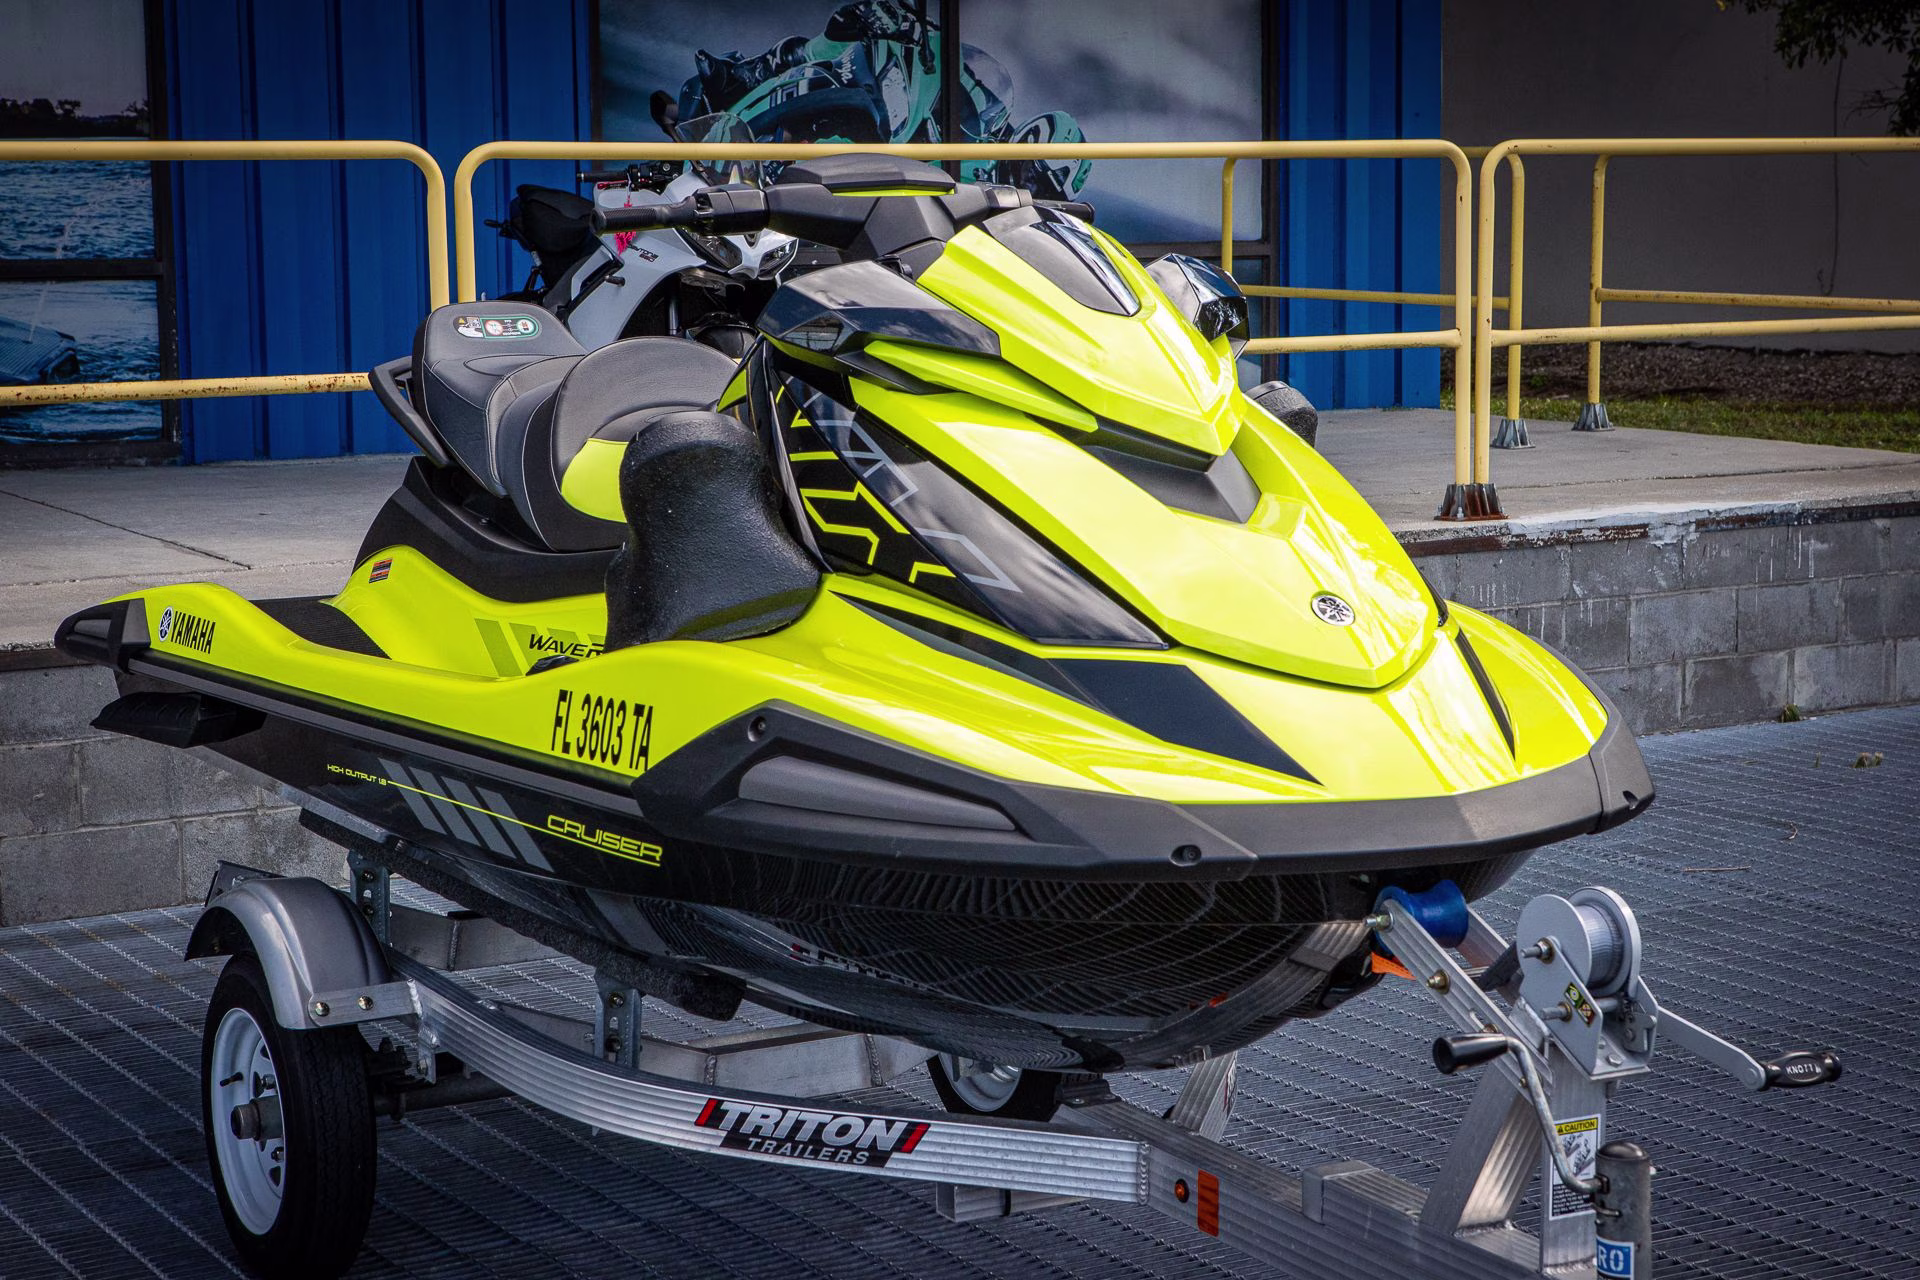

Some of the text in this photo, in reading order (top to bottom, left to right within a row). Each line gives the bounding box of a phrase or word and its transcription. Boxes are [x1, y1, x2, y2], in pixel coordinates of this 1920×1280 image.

[171, 610, 216, 654] YAMAHA
[551, 689, 653, 771] FL 3603 TA
[345, 769, 377, 782] OUTPUT
[547, 814, 663, 861] CRUISER
[719, 1101, 907, 1151] TRITON
[1564, 1120, 1595, 1132] CAUTION
[747, 1137, 870, 1165] TRAILERS
